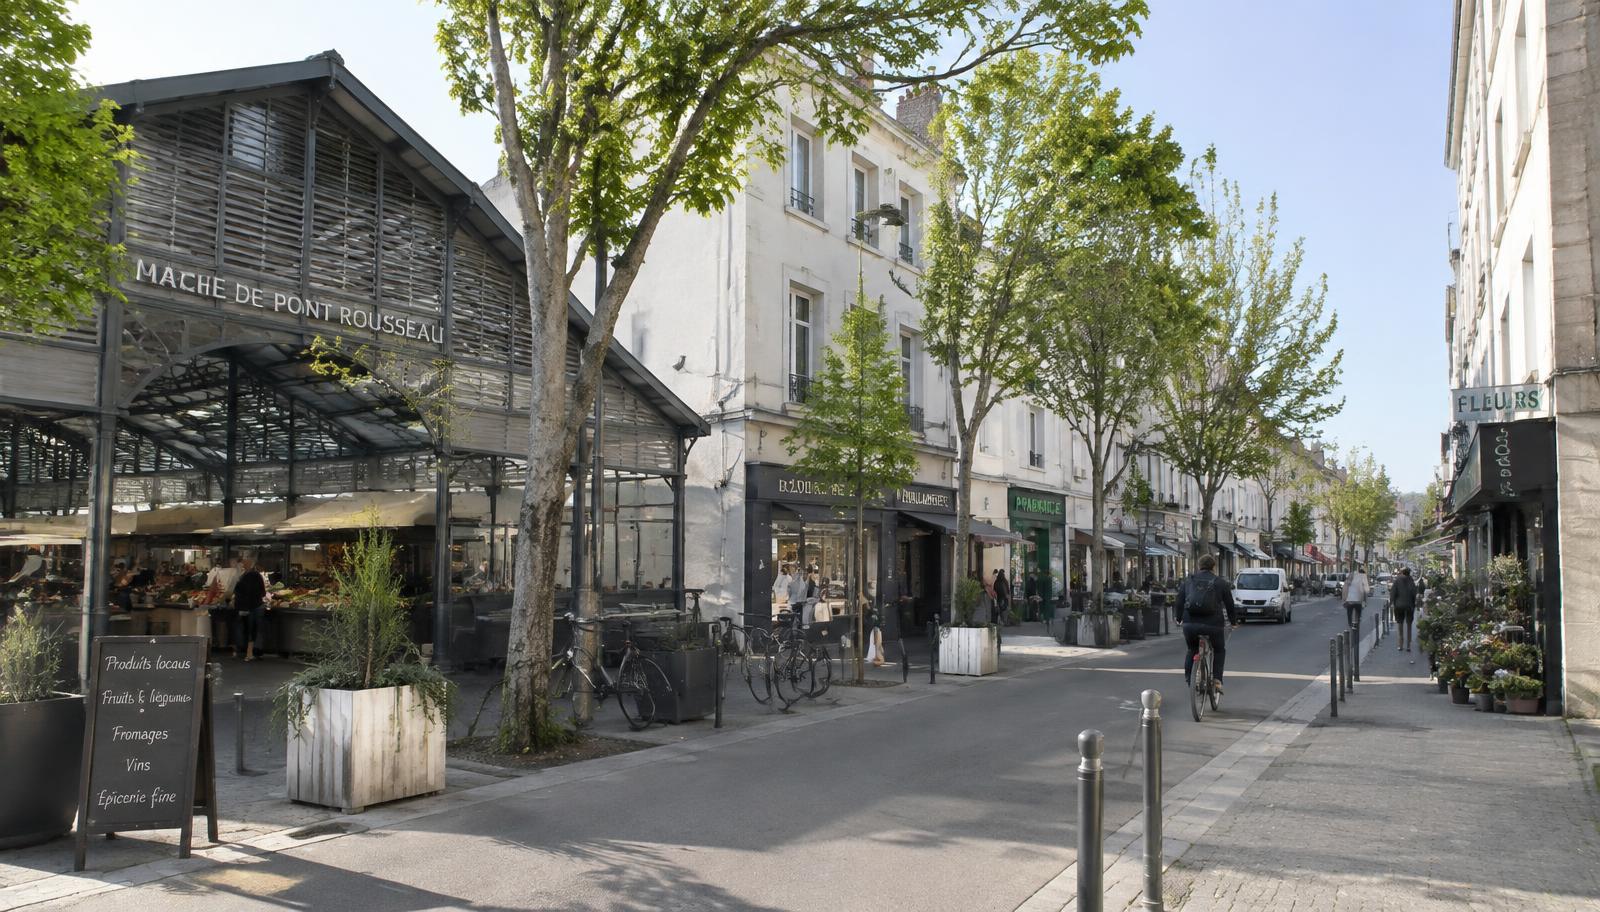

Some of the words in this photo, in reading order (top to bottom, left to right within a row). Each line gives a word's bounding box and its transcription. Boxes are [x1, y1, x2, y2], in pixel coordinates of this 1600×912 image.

[235, 282, 264, 308] DE
[274, 292, 332, 321] PONT
[340, 306, 444, 344] ROUSSEAU
[105, 654, 152, 671] Produits
[112, 725, 169, 745] Fromages
[126, 758, 151, 772] Vins
[151, 786, 177, 809] fine
